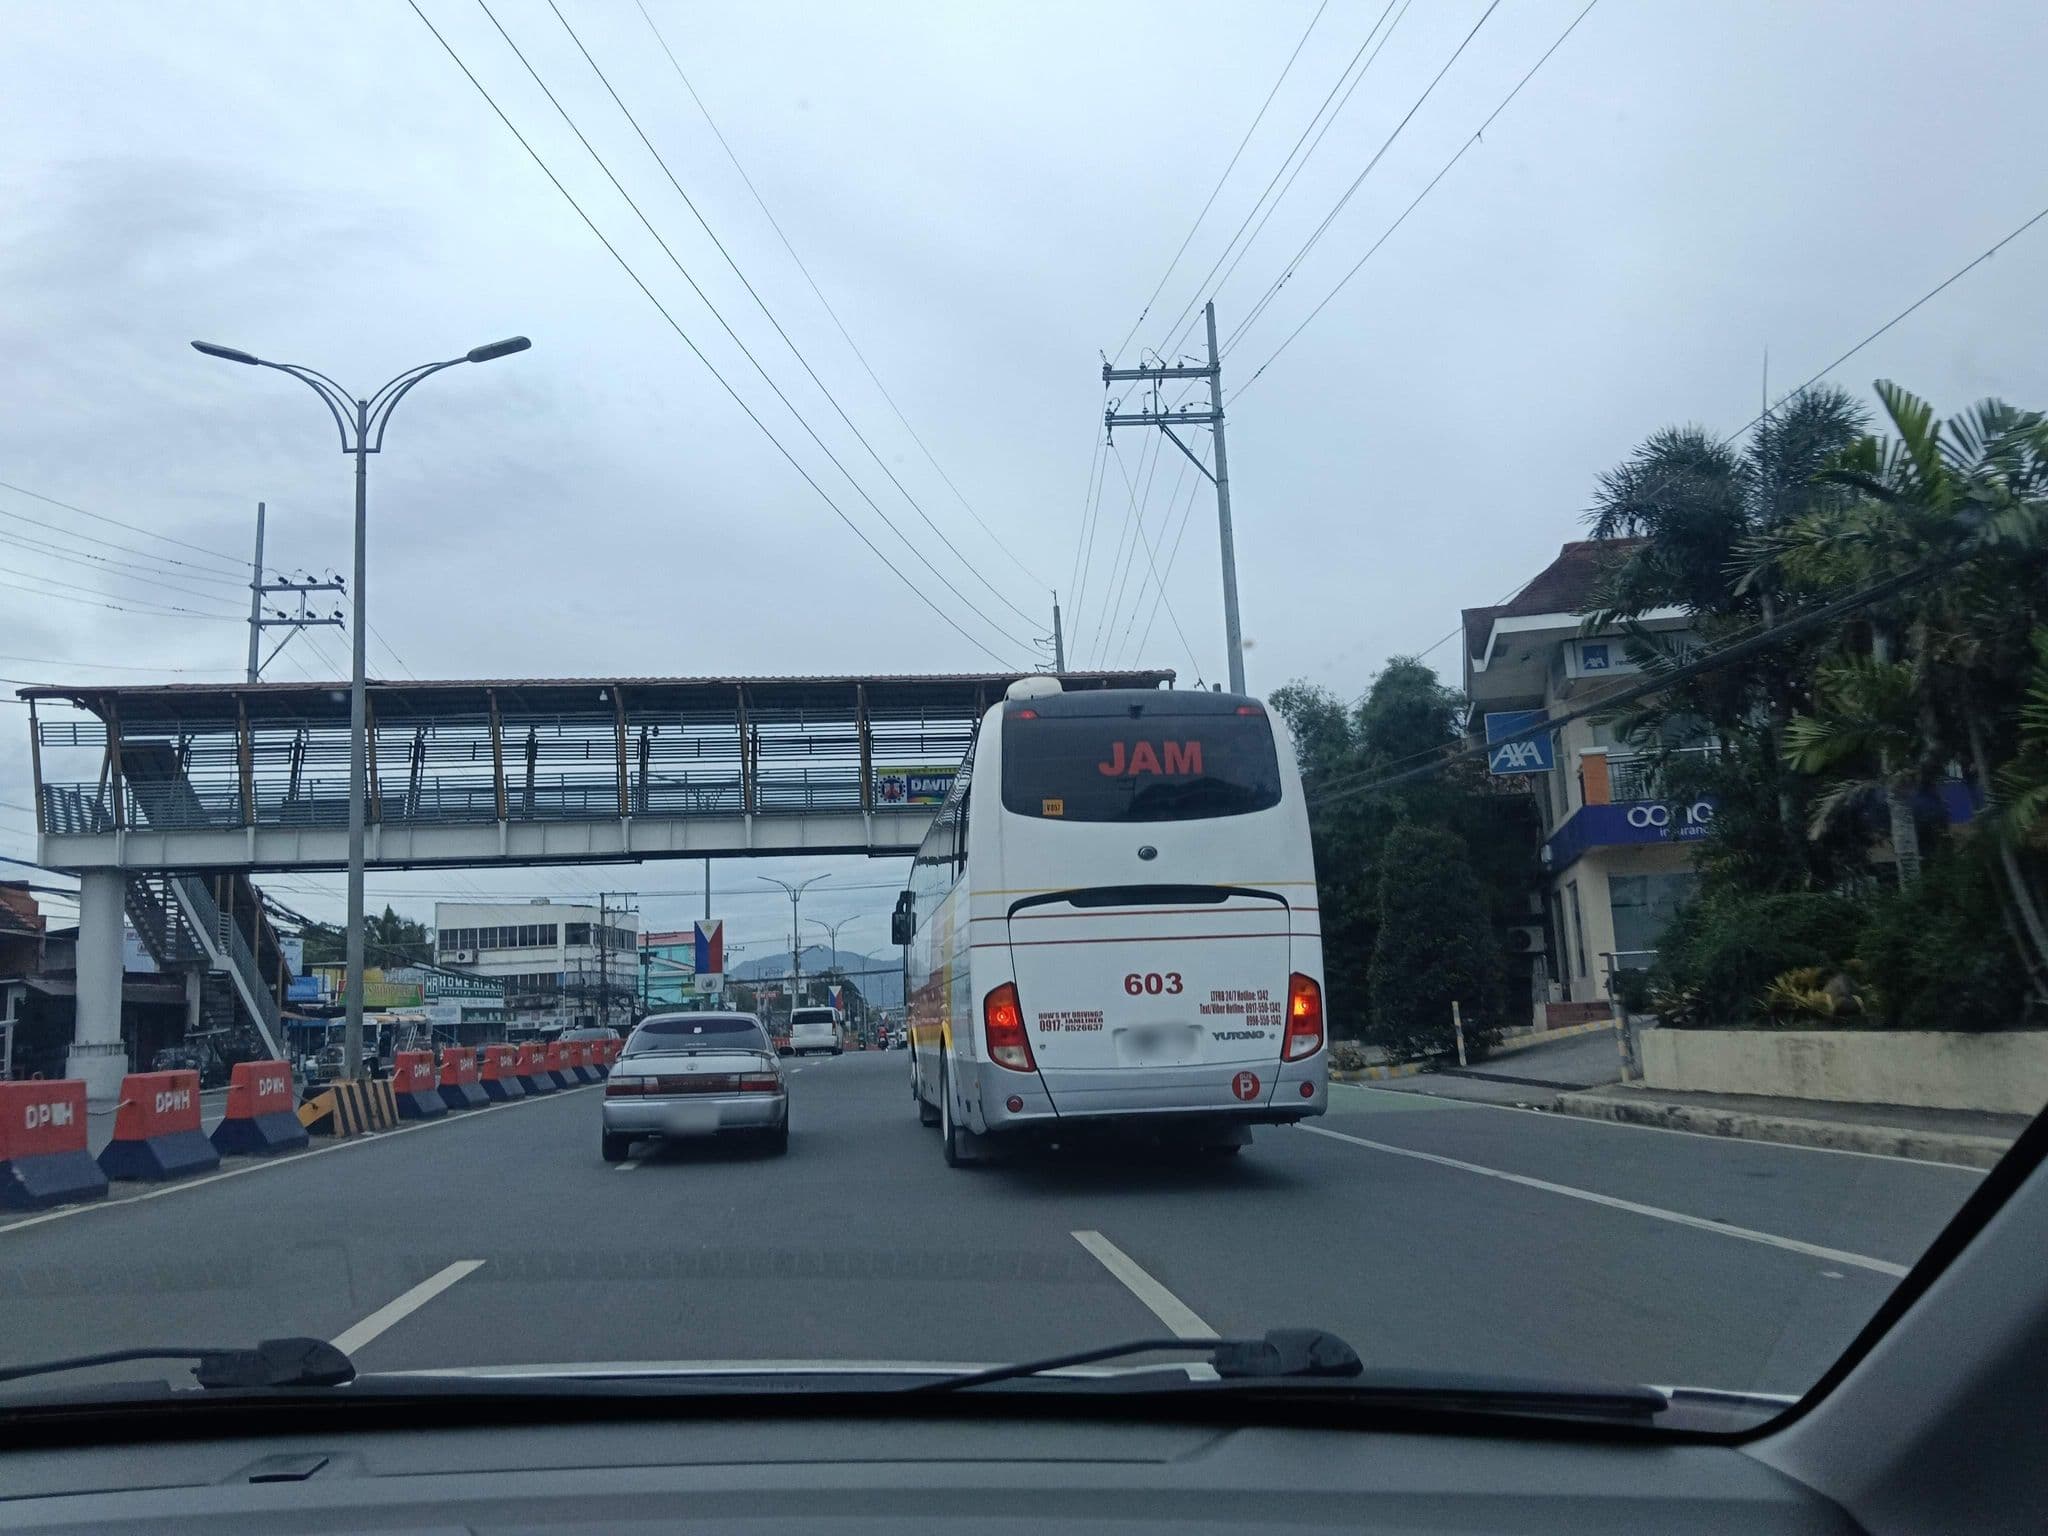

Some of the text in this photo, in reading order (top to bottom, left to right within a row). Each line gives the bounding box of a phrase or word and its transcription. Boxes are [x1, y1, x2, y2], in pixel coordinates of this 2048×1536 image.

[1585, 657, 1606, 667] AXA
[1098, 740, 1204, 776] JAM
[1490, 740, 1544, 769] AXA
[426, 976, 438, 993] HR
[440, 975, 470, 988] HOME
[1124, 972, 1183, 995] 603
[1072, 1010, 1103, 1018] DRIVING?
[1212, 1030, 1265, 1041] YUTONG
[259, 1077, 285, 1096] DPWH
[155, 1089, 190, 1114] DPWH
